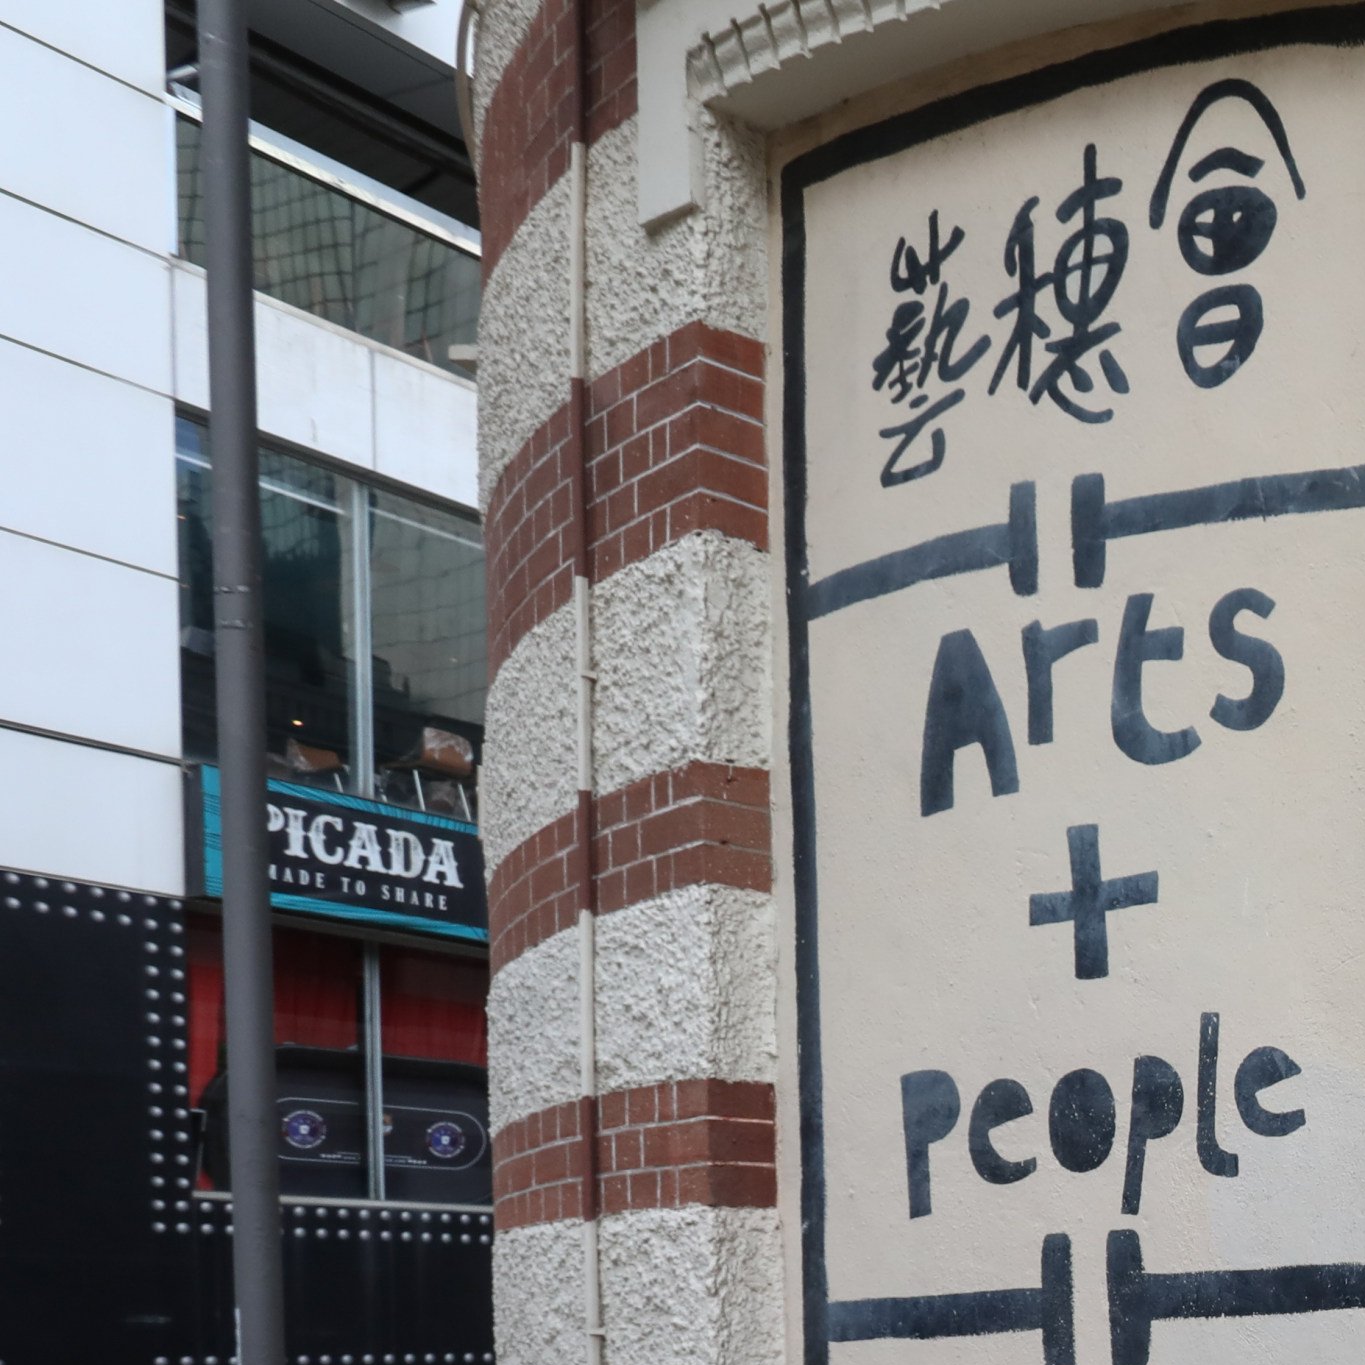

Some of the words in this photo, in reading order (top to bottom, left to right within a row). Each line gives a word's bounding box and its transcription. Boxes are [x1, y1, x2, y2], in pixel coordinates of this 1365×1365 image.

[920, 587, 1285, 817] Arts
[341, 876, 366, 895] TO
[381, 884, 448, 911] SHARE
[901, 1011, 1306, 1219] people
